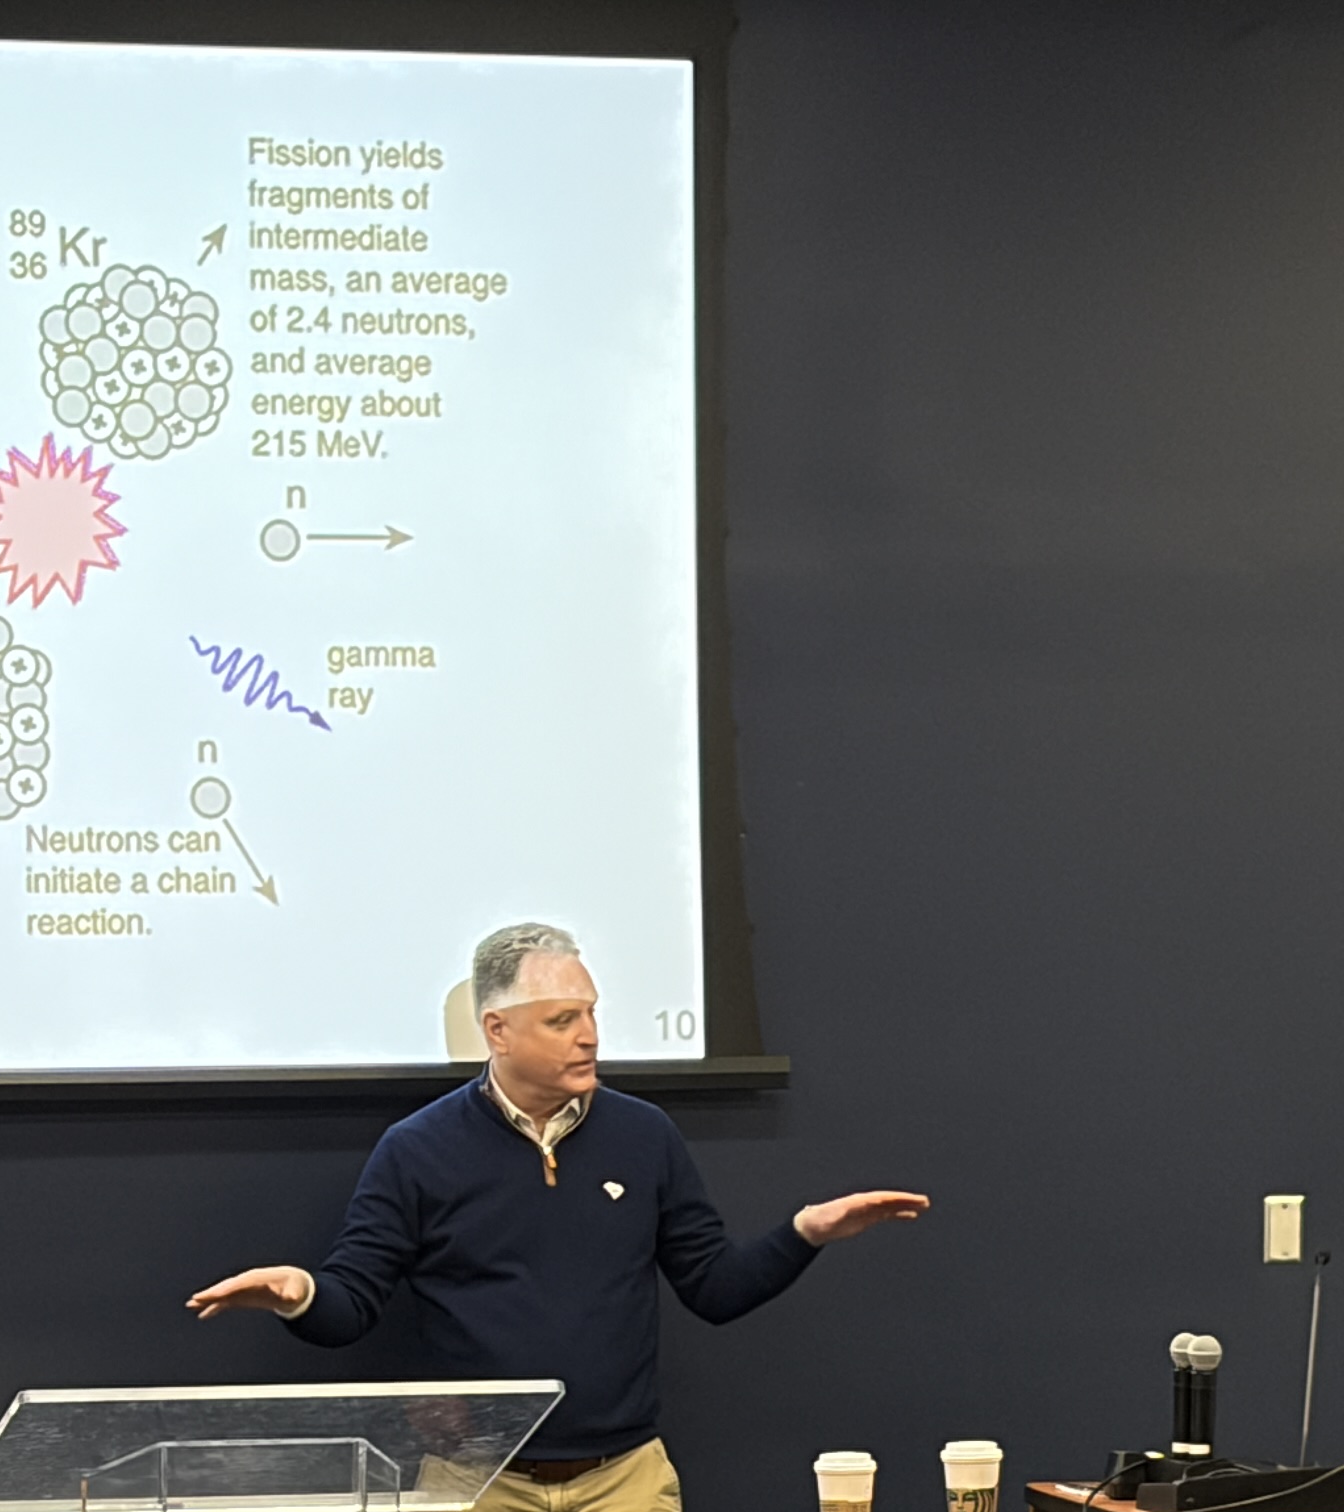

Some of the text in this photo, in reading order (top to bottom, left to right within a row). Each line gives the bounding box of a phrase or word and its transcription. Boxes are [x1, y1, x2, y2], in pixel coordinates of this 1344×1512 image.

[249, 137, 443, 176] Fission yields
[247, 178, 430, 215] fragments of
[9, 209, 46, 238] 89
[249, 220, 428, 252] intermediate
[9, 226, 107, 280] 36 Kr
[250, 268, 507, 302] mass, an average
[249, 303, 475, 340] of 2.4 neutrons,
[250, 345, 432, 383] and average
[251, 388, 442, 423] energy about
[251, 429, 387, 458] 215 MeV.
[287, 485, 306, 508] n
[327, 646, 436, 675] gamma
[329, 687, 374, 715] ray
[198, 740, 217, 763] n
[26, 824, 221, 853] Neutrons can
[26, 865, 236, 894] initiate a chain
[27, 907, 152, 935] reaction.
[656, 1010, 695, 1041] 10
